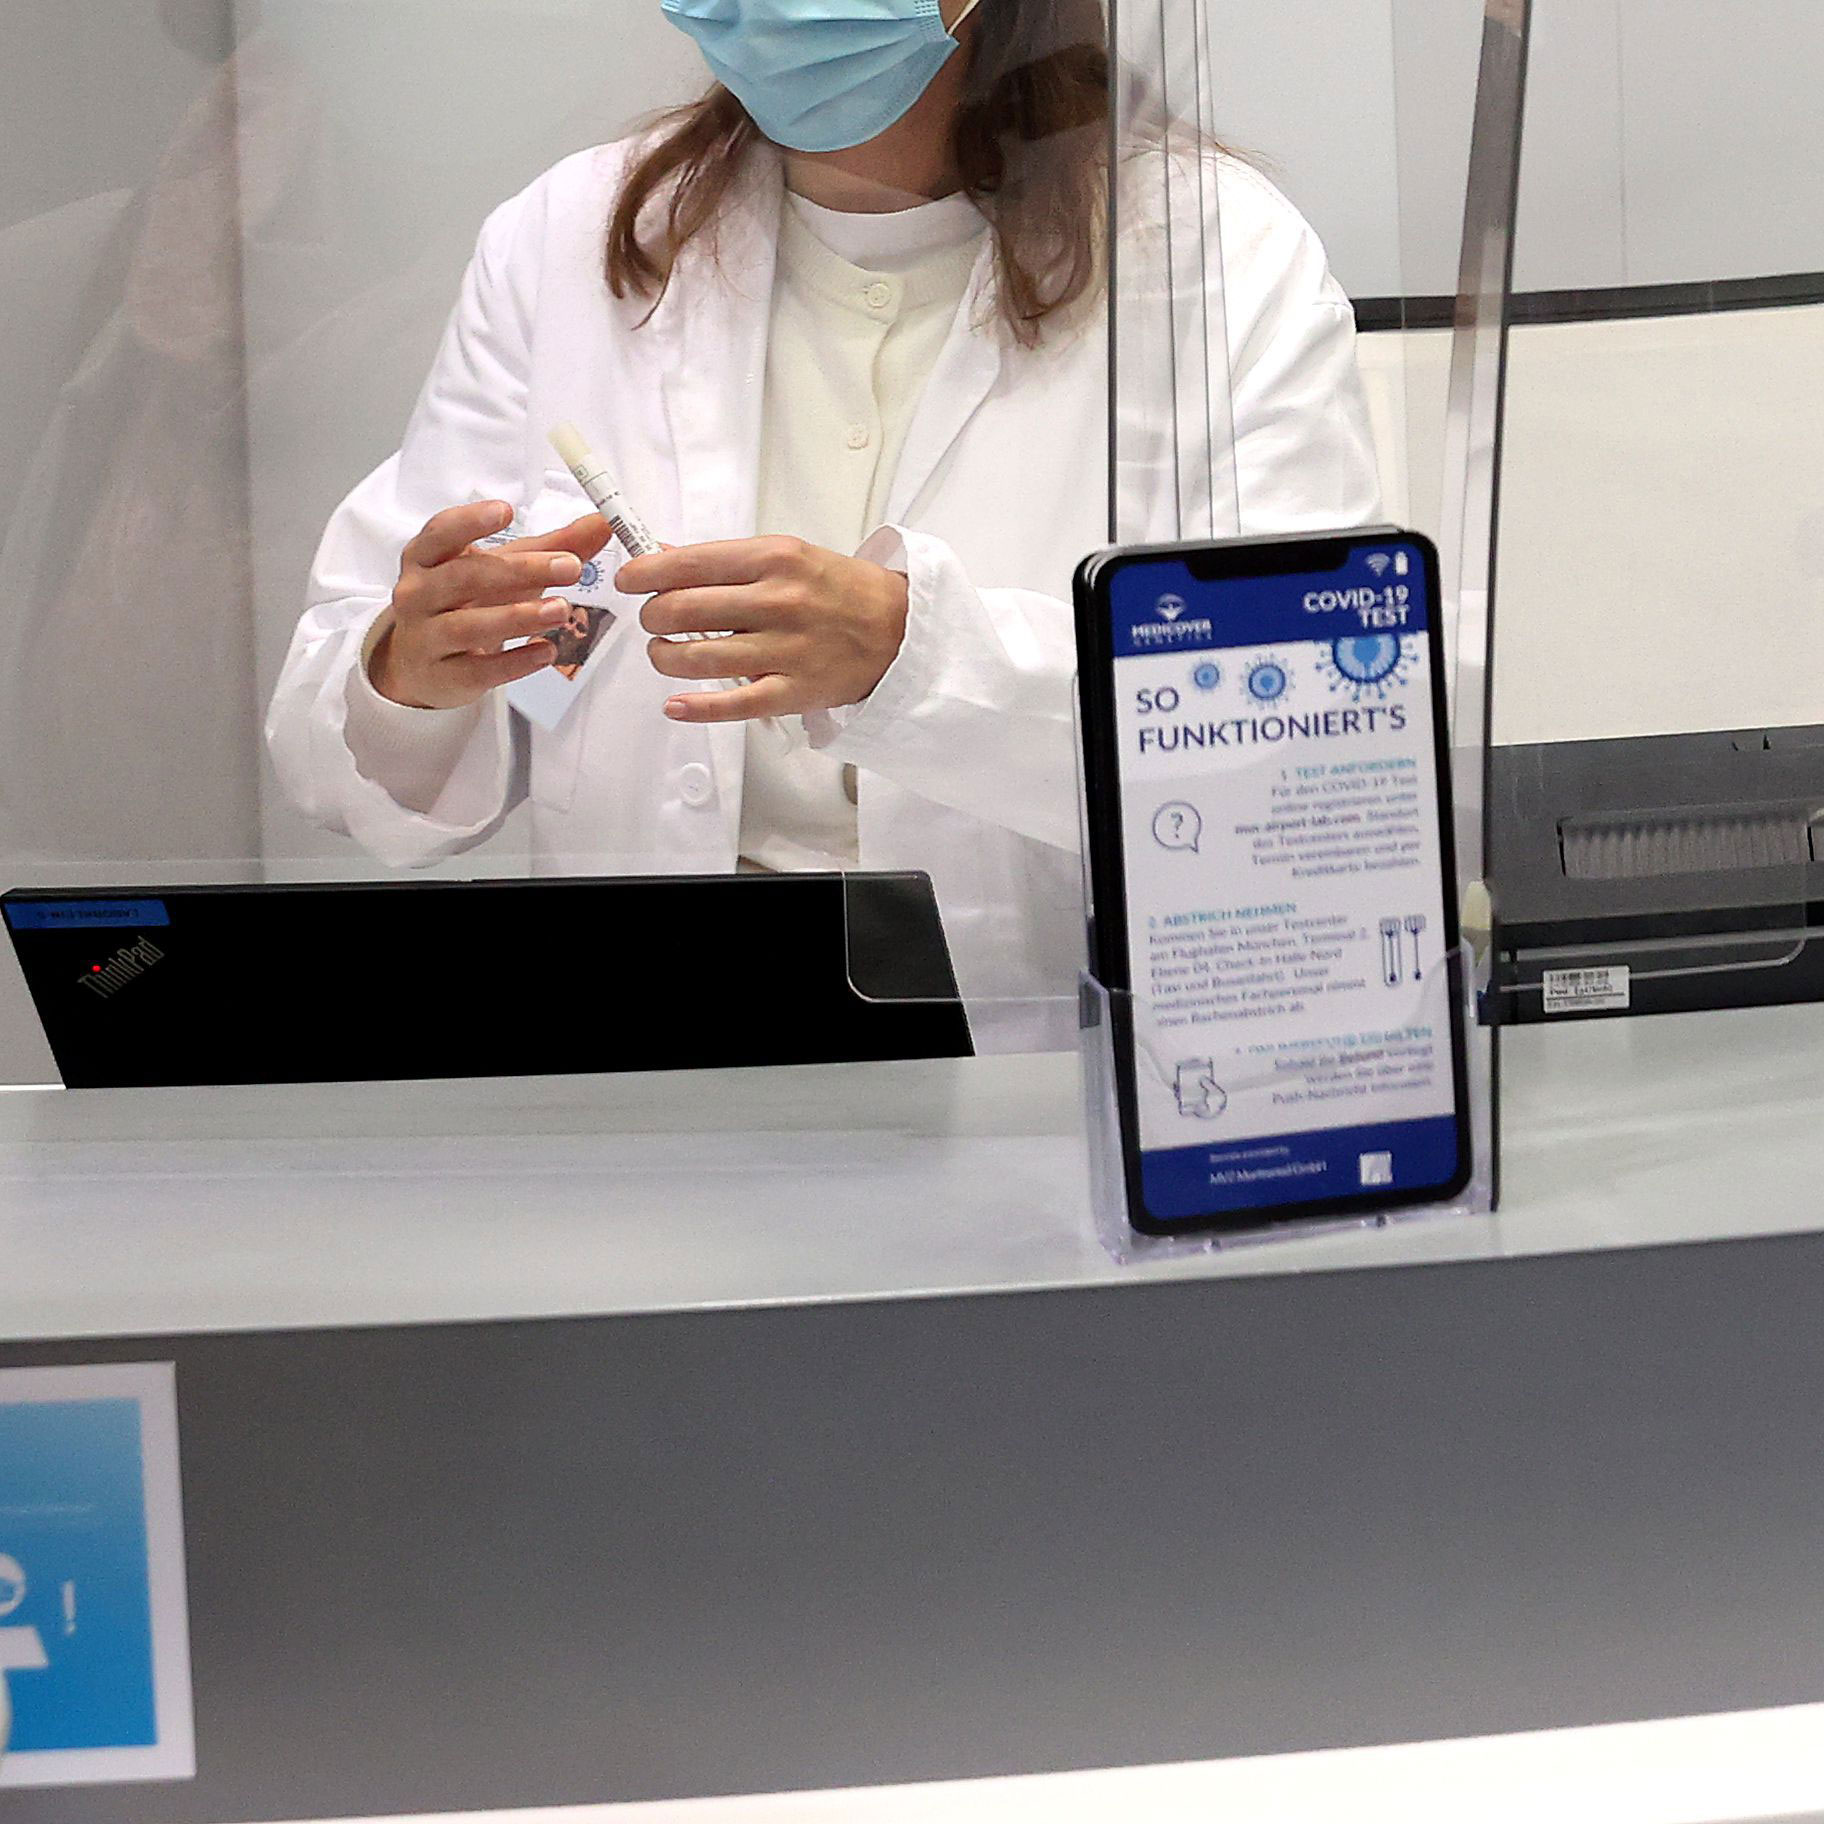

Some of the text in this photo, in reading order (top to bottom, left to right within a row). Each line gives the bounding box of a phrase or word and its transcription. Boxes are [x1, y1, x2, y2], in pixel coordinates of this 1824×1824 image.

[1303, 583, 1409, 614] COVID-19
[1357, 606, 1409, 629] TEST
[1135, 686, 1180, 715] SO
[1138, 703, 1407, 755] FUNKTIONIERT'S
[77, 935, 165, 999] ThinkPad
